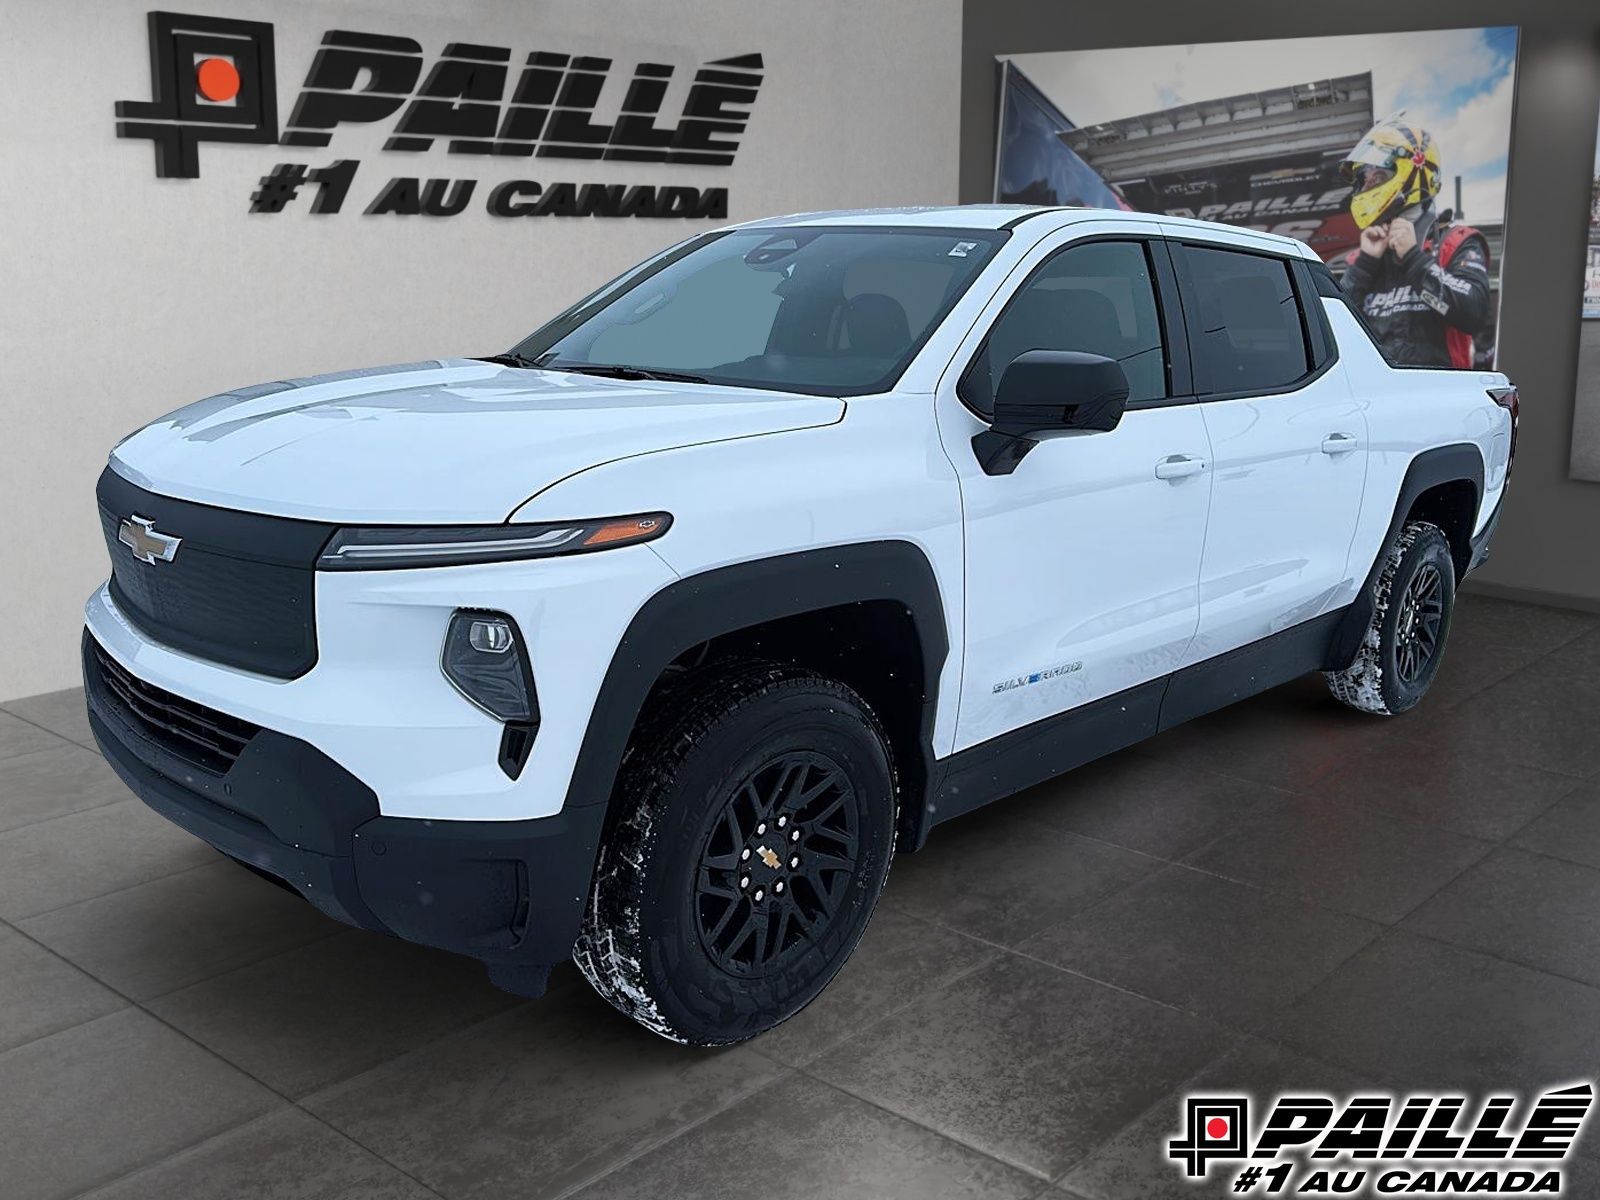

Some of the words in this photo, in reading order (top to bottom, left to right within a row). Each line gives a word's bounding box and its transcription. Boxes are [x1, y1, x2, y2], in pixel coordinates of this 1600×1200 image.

[278, 29, 764, 166] PAILLÉ
[248, 159, 361, 214] #1
[362, 176, 478, 216] AU
[486, 180, 729, 219] CANADA
[1250, 174, 1321, 188] CHEVROLET
[1254, 204, 1341, 217] CANADA
[992, 661, 1083, 693] SILVERADO
